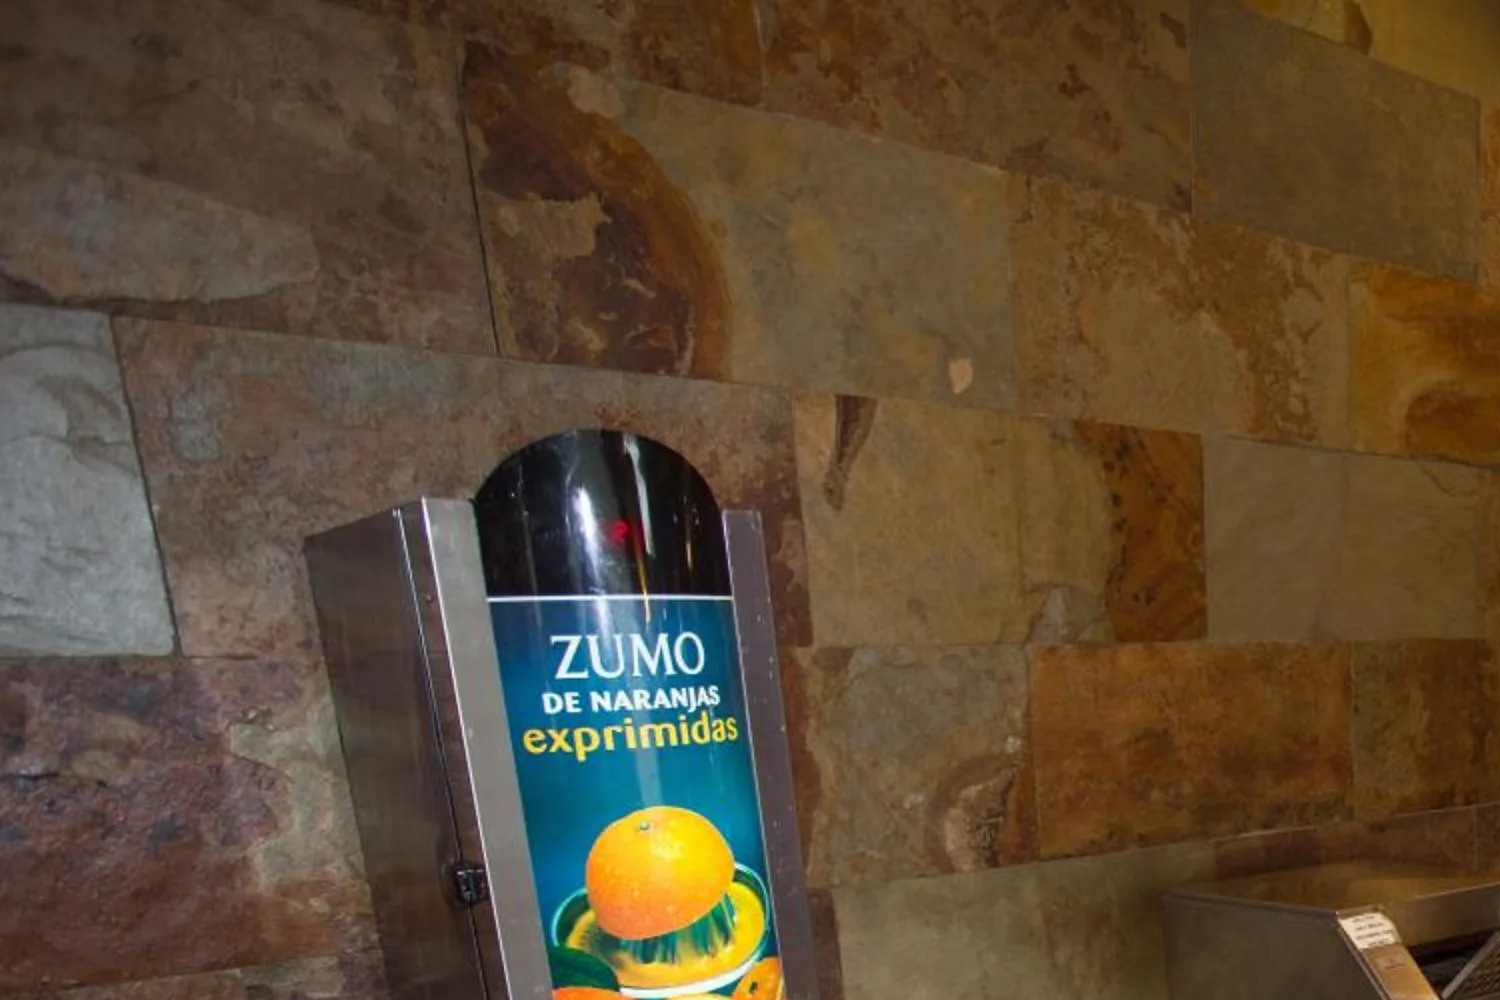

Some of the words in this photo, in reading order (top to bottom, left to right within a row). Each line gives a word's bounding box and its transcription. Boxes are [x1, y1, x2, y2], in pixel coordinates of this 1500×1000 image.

[551, 632, 705, 680] ZUMO
[542, 692, 581, 714] DE
[589, 685, 720, 713] NARANJAS
[522, 711, 738, 762] exprimidas
